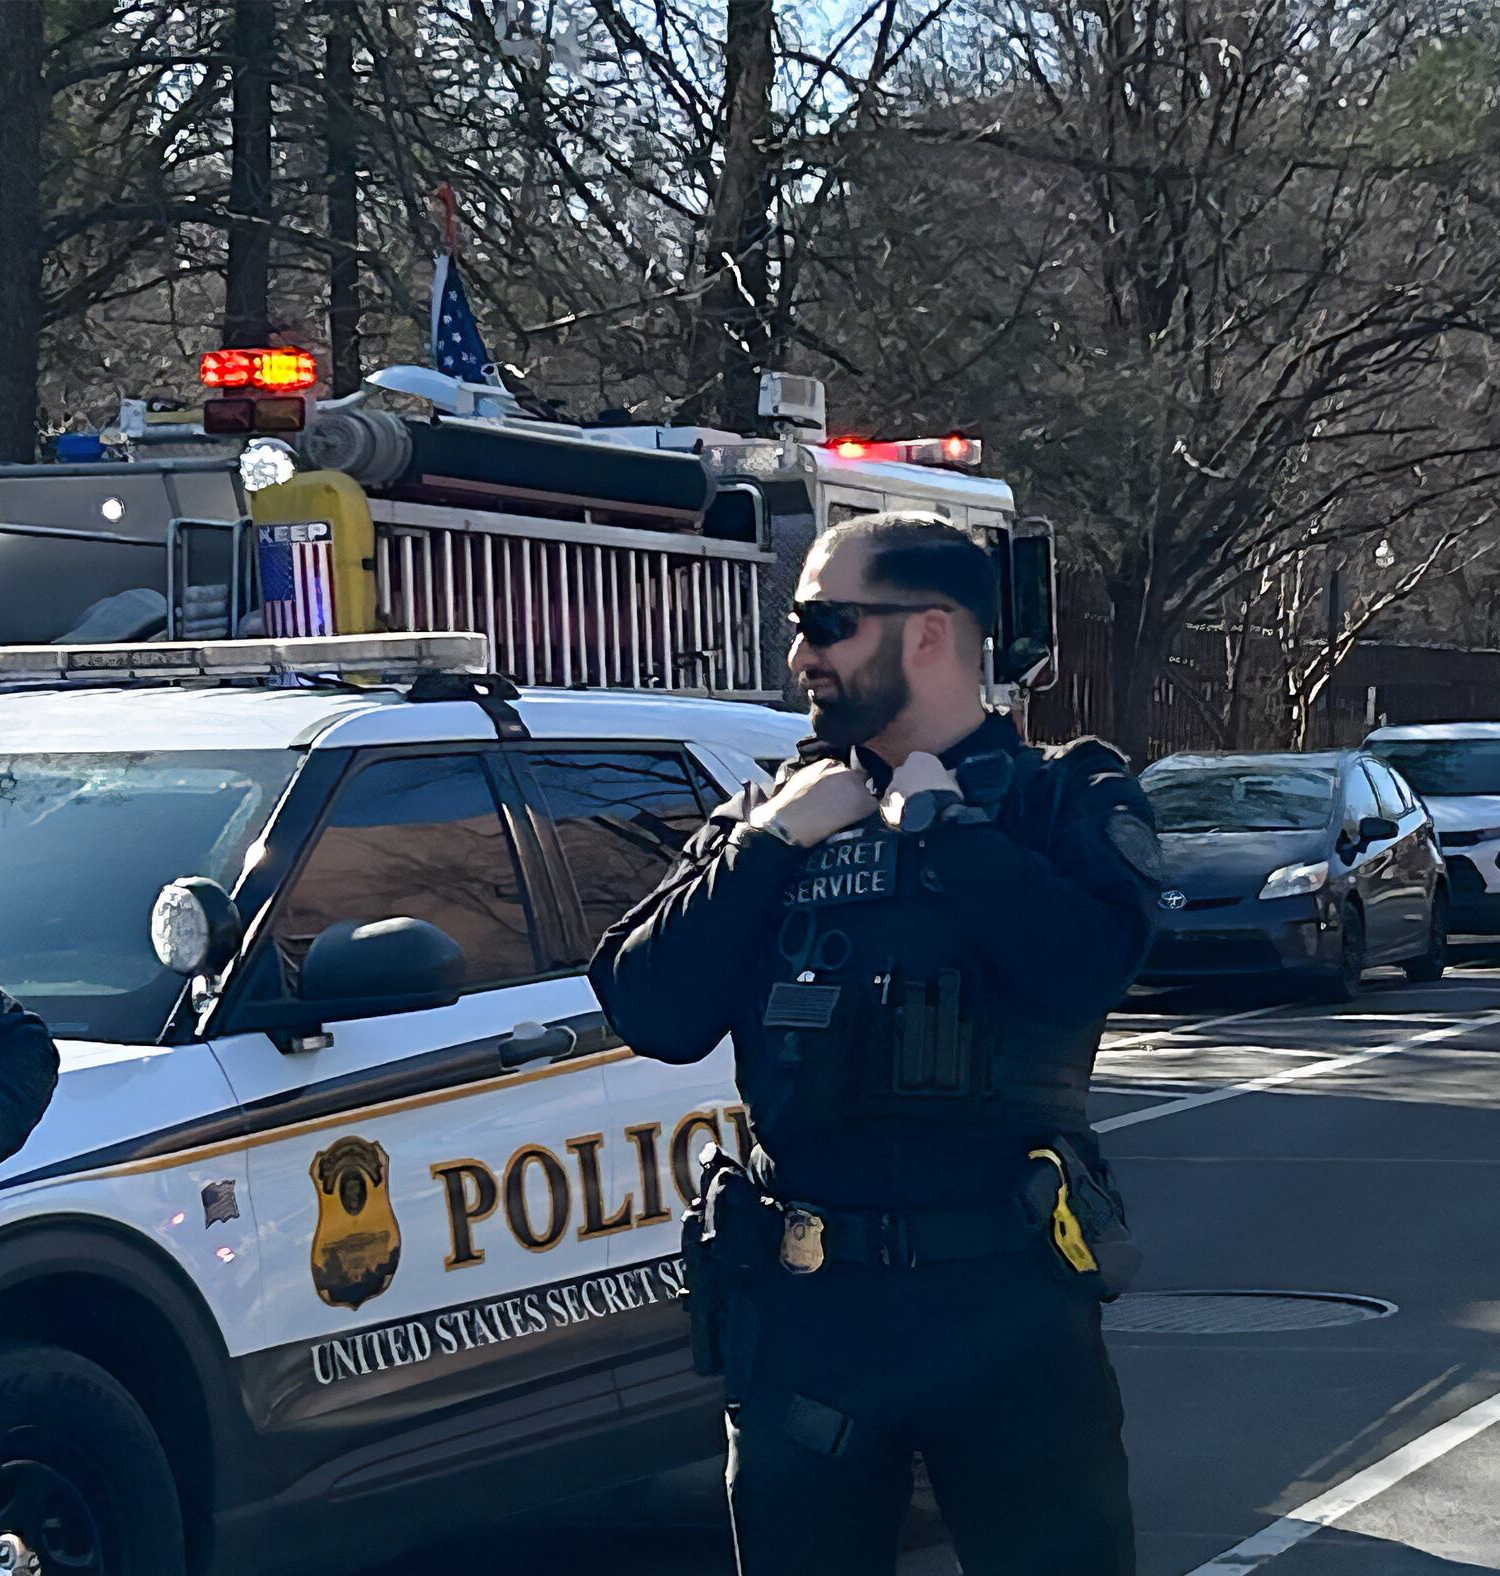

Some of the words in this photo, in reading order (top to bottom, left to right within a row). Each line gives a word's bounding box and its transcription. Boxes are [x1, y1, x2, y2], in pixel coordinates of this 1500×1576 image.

[259, 522, 328, 544] KEEP
[805, 840, 888, 872] ECRET
[311, 1320, 432, 1385] UNITED
[434, 1293, 548, 1355] STATES
[545, 1265, 660, 1327] SECRET
